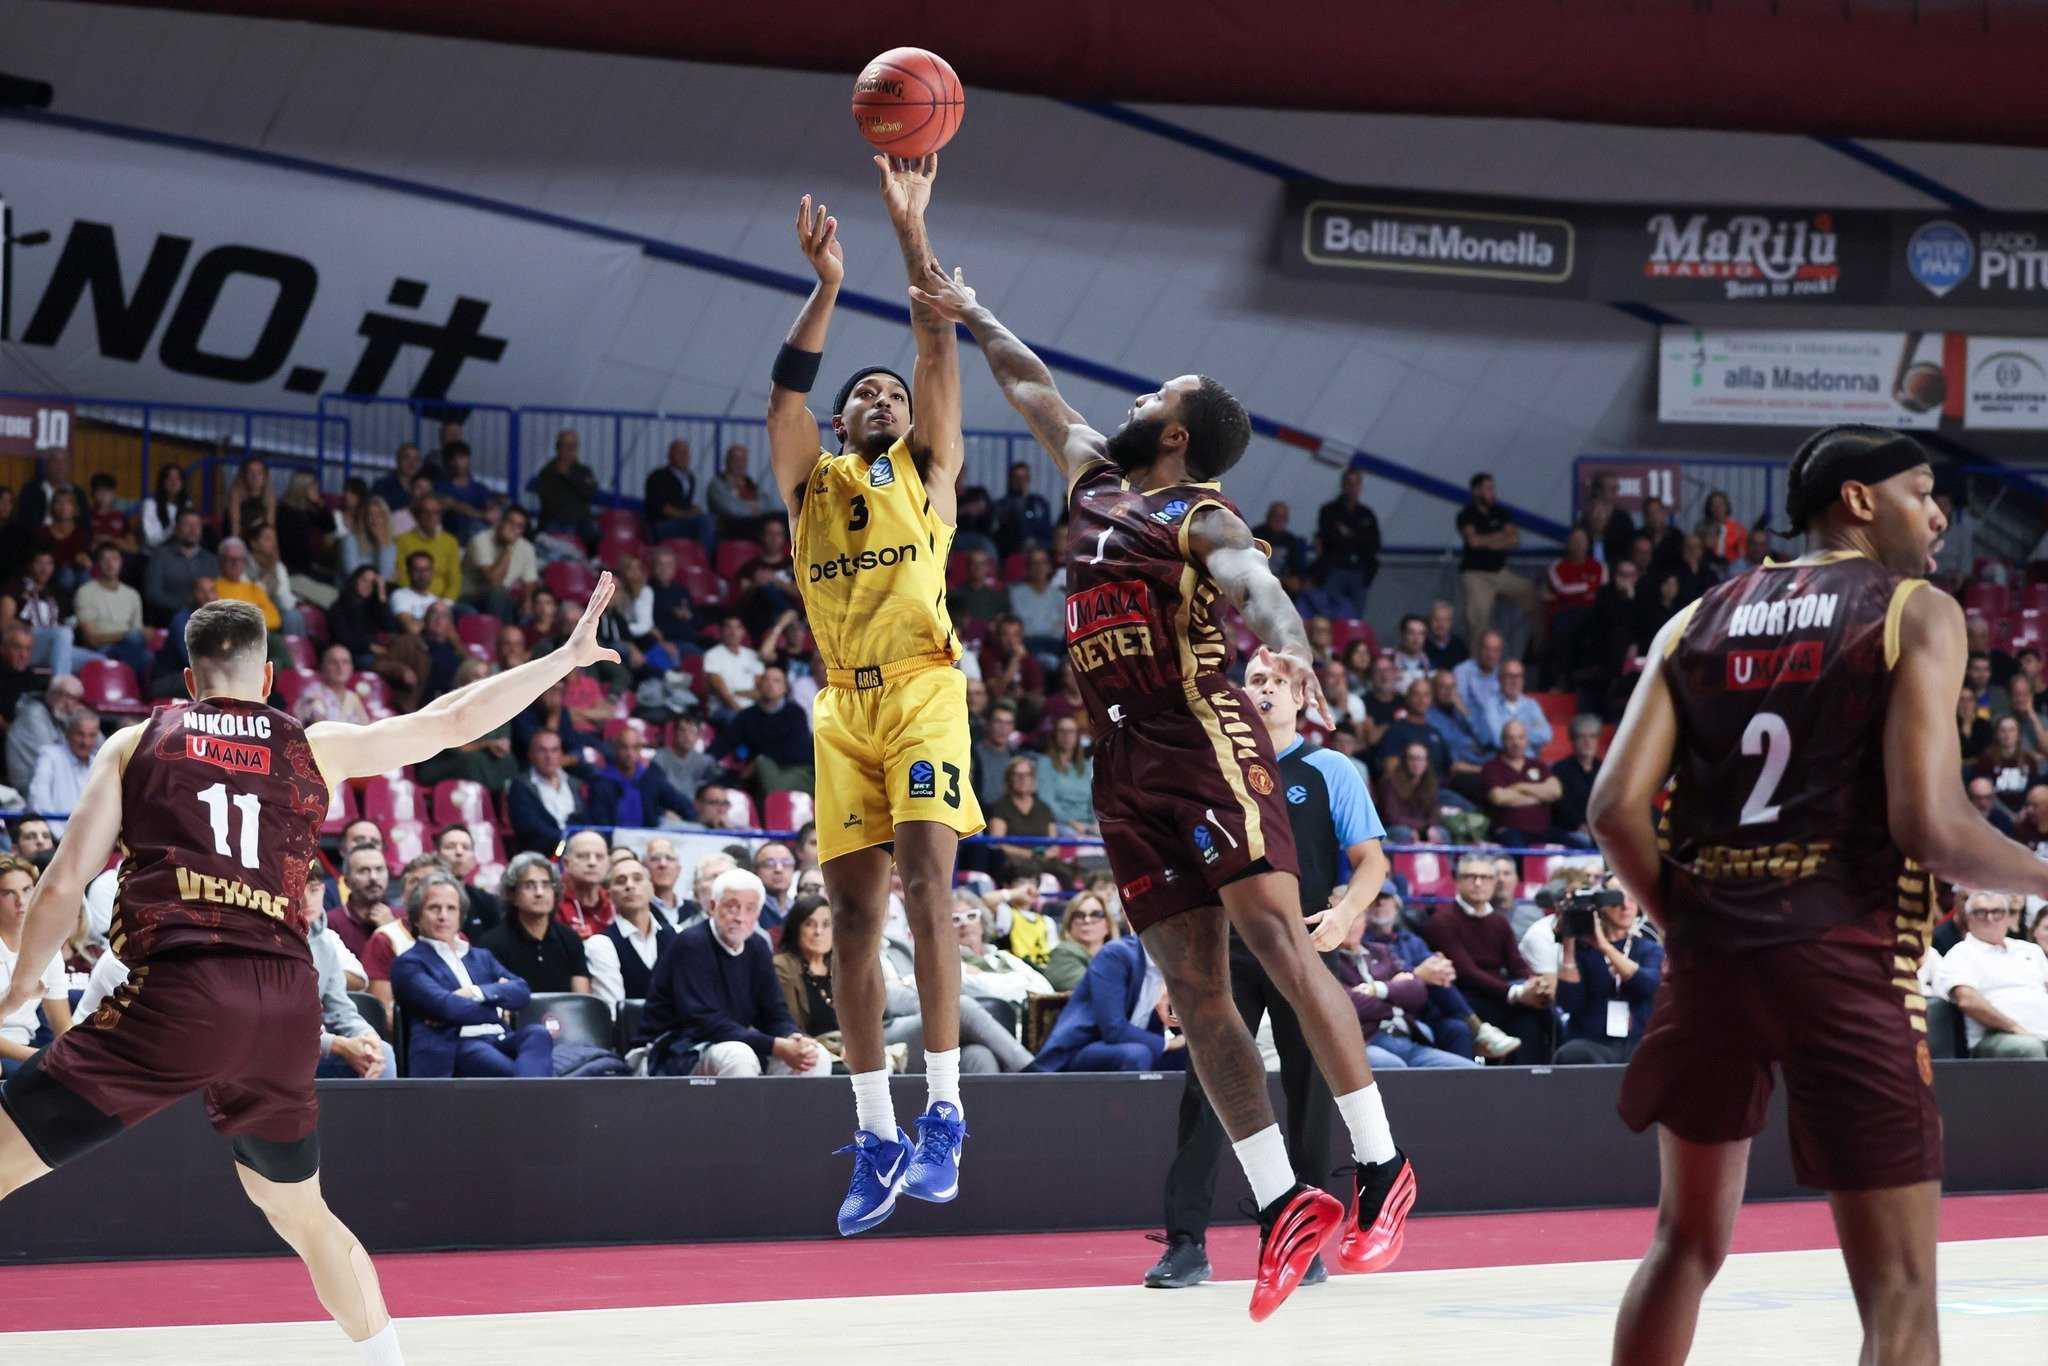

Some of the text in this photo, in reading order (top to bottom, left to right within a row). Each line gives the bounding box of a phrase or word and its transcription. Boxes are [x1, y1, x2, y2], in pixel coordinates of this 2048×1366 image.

[1980, 250, 2048, 290] PIT
[1724, 366, 1880, 392] alla Madonna
[36, 408, 69, 450] 10
[848, 494, 869, 532] 3
[1090, 525, 1115, 565] 1
[1067, 588, 1144, 634] UMANA
[1728, 594, 1838, 637] HORTON
[857, 669, 879, 688] ARIS
[183, 711, 272, 739] NIKOLIC
[192, 738, 263, 769] UMANA
[1738, 712, 1791, 827] 2
[942, 760, 961, 810] 3
[197, 782, 262, 869] 11
